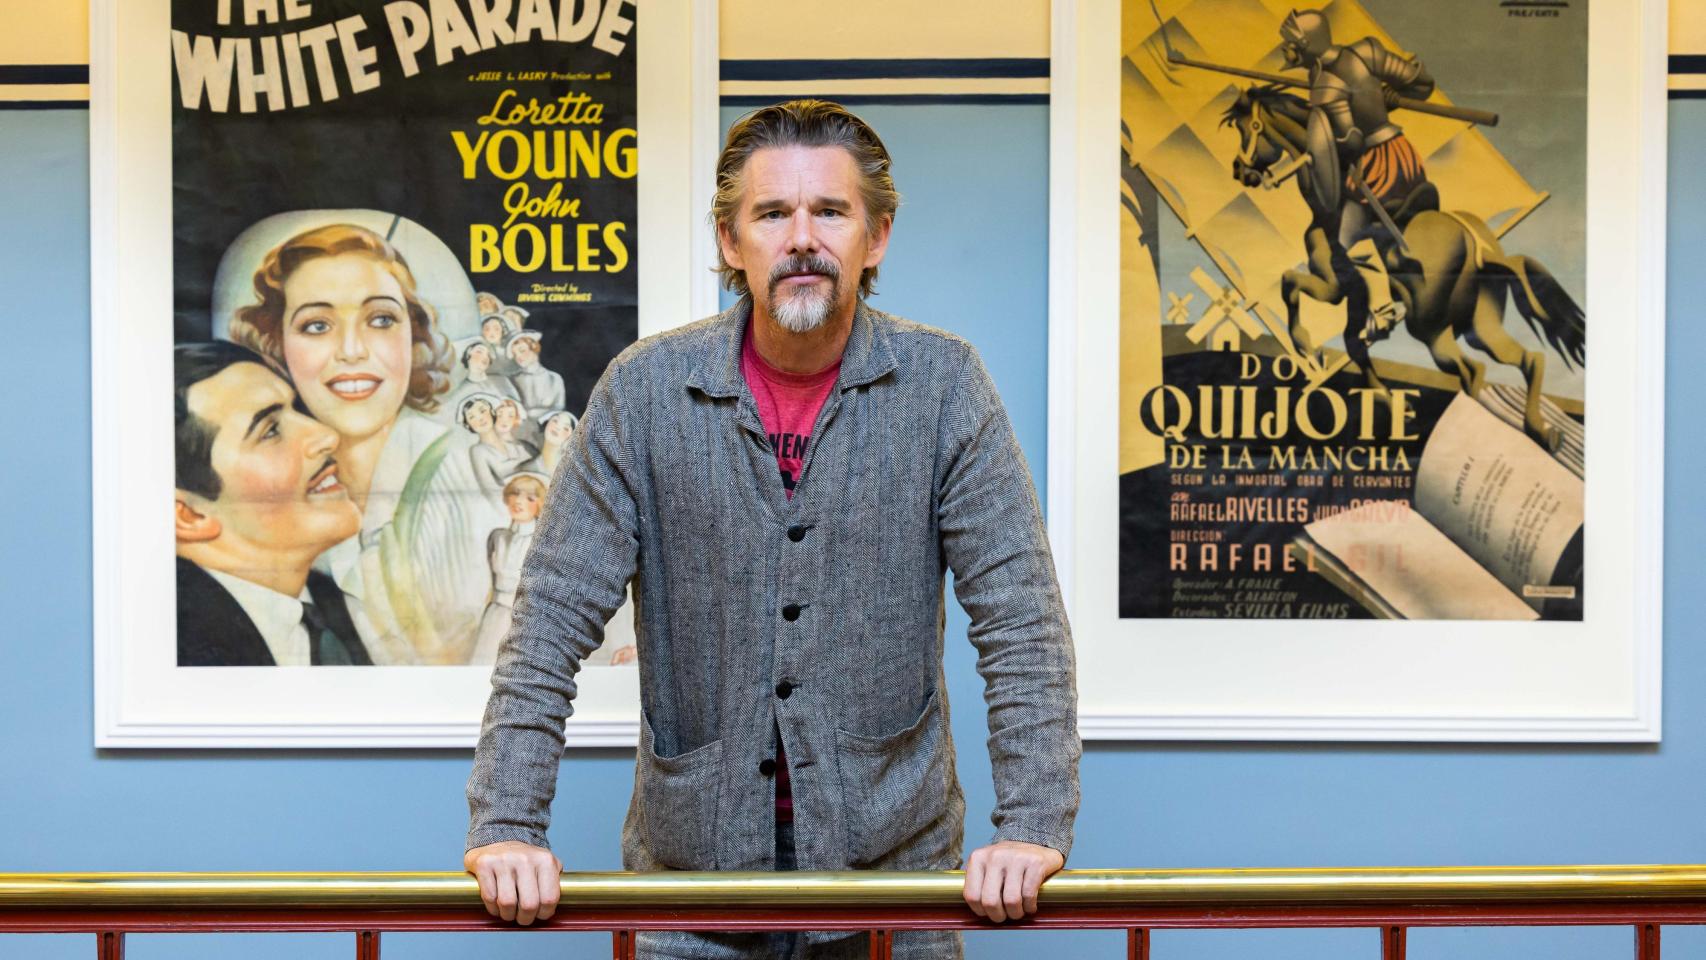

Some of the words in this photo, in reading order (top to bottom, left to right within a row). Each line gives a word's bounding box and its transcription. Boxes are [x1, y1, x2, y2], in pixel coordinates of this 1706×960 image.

[171, 14, 381, 113] WHITE
[383, 0, 637, 78] PARADE
[476, 71, 502, 82] JESSE
[506, 71, 516, 81] L.
[518, 71, 548, 81] LASKY
[550, 71, 593, 81] Production
[595, 71, 612, 81] with
[477, 89, 604, 126] Loretta
[450, 128, 637, 180] YOUNG
[502, 181, 581, 229] John
[470, 221, 629, 273] BOLES
[517, 293, 546, 303] IRVING
[548, 293, 593, 303] CUMMINGS
[531, 283, 568, 293] Directed
[569, 283, 579, 295] by
[1140, 384, 1421, 442] QUIJOTE
[1170, 445, 1207, 469] DE
[1221, 445, 1255, 470] LA
[1269, 445, 1412, 471] MANCHA
[1212, 475, 1226, 486] LA
[1235, 475, 1287, 487] INMORTAL
[1297, 475, 1323, 487] OBRA
[1332, 476, 1344, 487] DE
[1353, 476, 1411, 488] CERVANTES
[1171, 503, 1226, 522] RAFAEL
[1226, 496, 1308, 522] RIVELLES
[1170, 543, 1319, 572] RAFAEL
[1223, 603, 1292, 618] SEVILLA
[1300, 603, 1349, 618] FILMS
